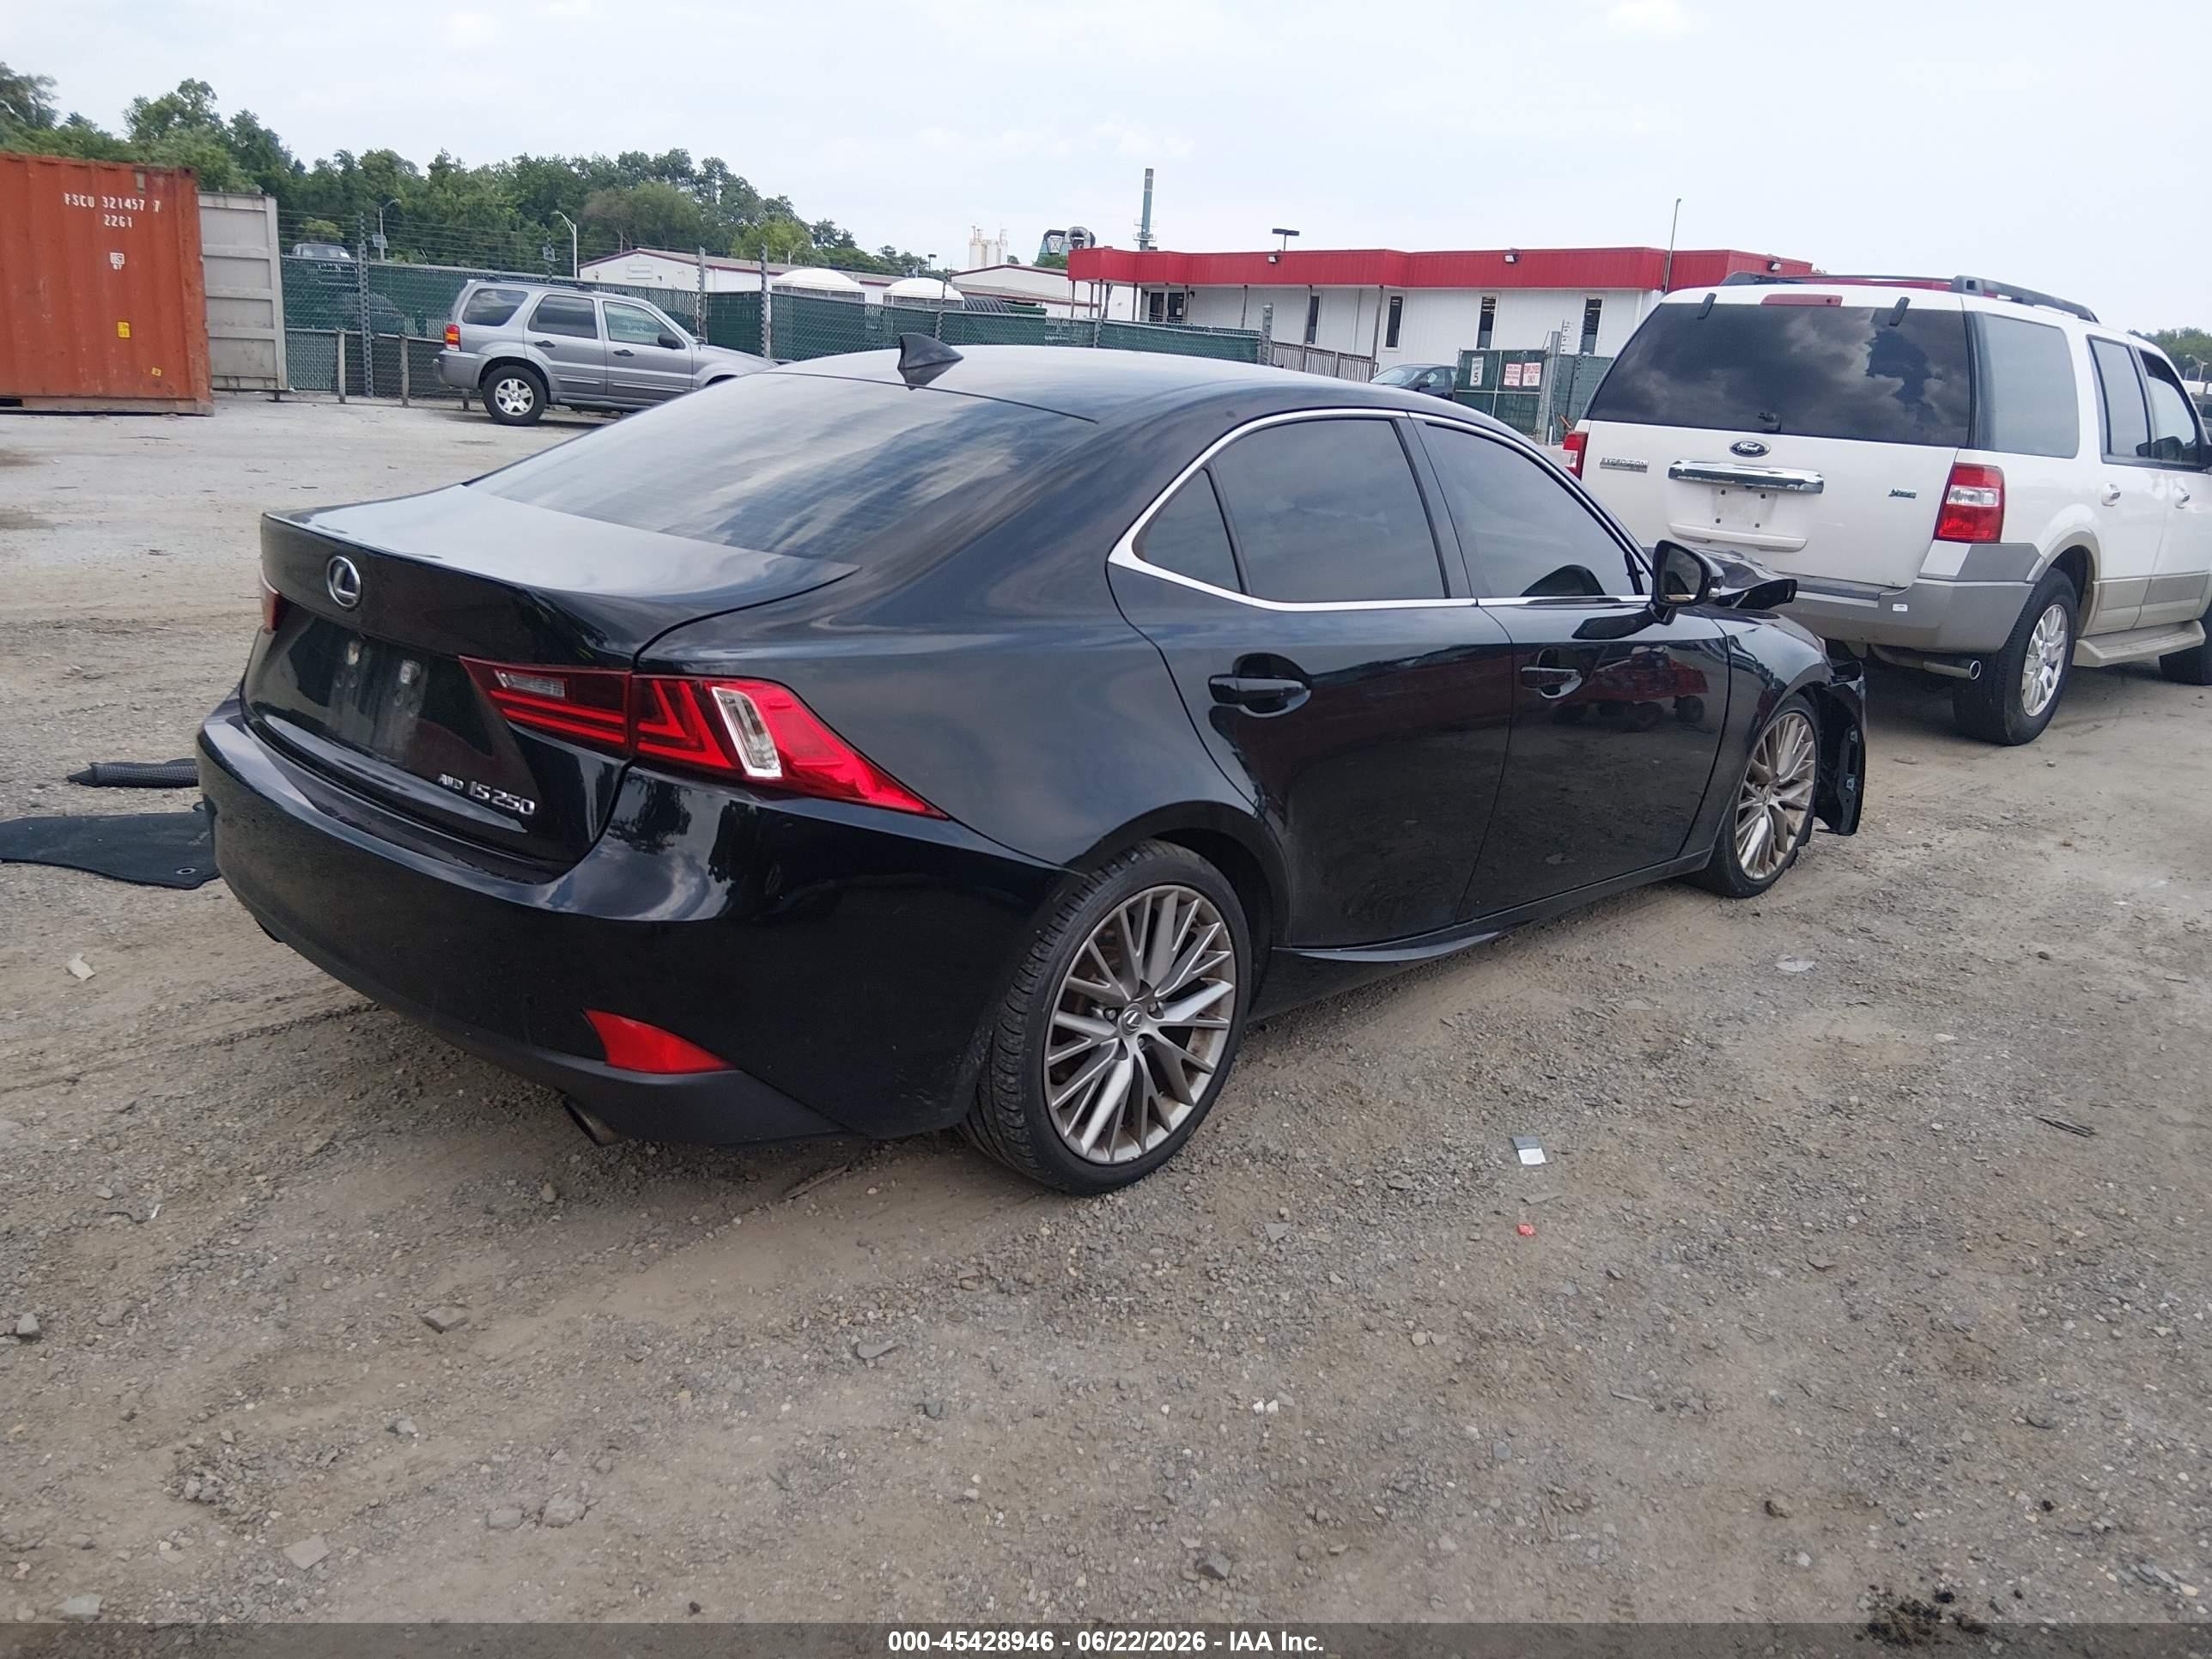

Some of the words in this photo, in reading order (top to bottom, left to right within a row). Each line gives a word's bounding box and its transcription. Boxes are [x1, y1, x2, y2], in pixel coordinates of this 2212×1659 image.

[64, 192, 95, 208] FSCU
[102, 196, 145, 211] 321457
[104, 214, 133, 228] 2261
[1473, 372, 1479, 383] 5
[1599, 457, 1649, 471] EXPEDITION
[438, 773, 465, 791] AWD
